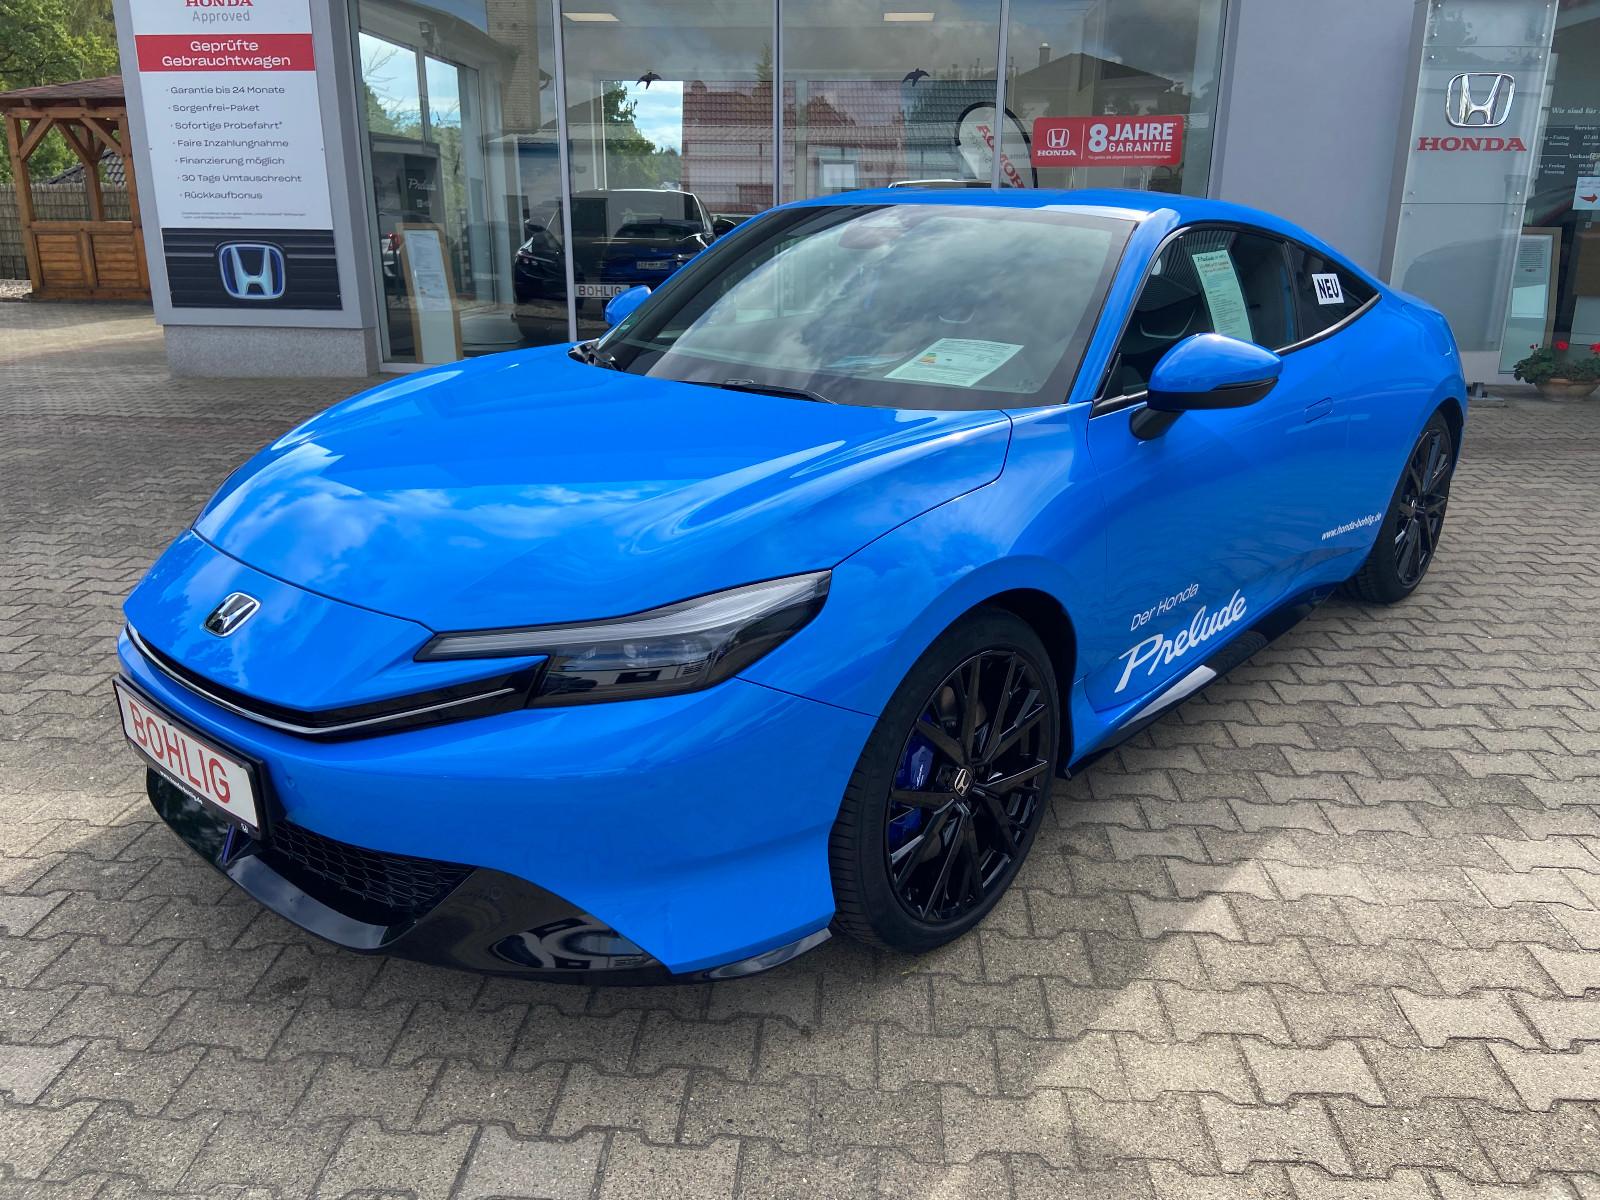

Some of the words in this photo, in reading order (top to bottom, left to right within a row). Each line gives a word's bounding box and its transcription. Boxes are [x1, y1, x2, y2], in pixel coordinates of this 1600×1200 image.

[192, 10, 251, 24] Approved
[190, 39, 259, 53] Geprüfte
[161, 55, 291, 69] Gebrauchtwagen
[170, 85, 214, 94] Garantie
[215, 85, 231, 94] bis
[232, 86, 245, 94] 24
[247, 86, 285, 94] Monate
[172, 103, 260, 114] Sorgenfrei-Paket
[175, 121, 222, 132] Sofortige
[1087, 122, 1109, 153] 8
[177, 139, 202, 148] Faire
[204, 139, 289, 149] Inzahlungnahme
[1108, 142, 1172, 153] GARANTIE
[1416, 137, 1527, 152] HONDA
[1036, 149, 1077, 157] HONDA
[179, 156, 244, 167] Finanzierung
[246, 156, 285, 167] möglich
[181, 174, 196, 182] 30
[197, 174, 221, 184] Tage
[222, 174, 303, 183] Umtauschrecht
[184, 191, 263, 200] Rückkaufbonus
[578, 285, 622, 297] BOHLIG
[1316, 278, 1340, 299] NEU
[1130, 606, 1158, 632] Der
[1156, 582, 1199, 616] Honda
[1113, 588, 1247, 694] Prelude
[128, 700, 231, 805] BOHLIG
